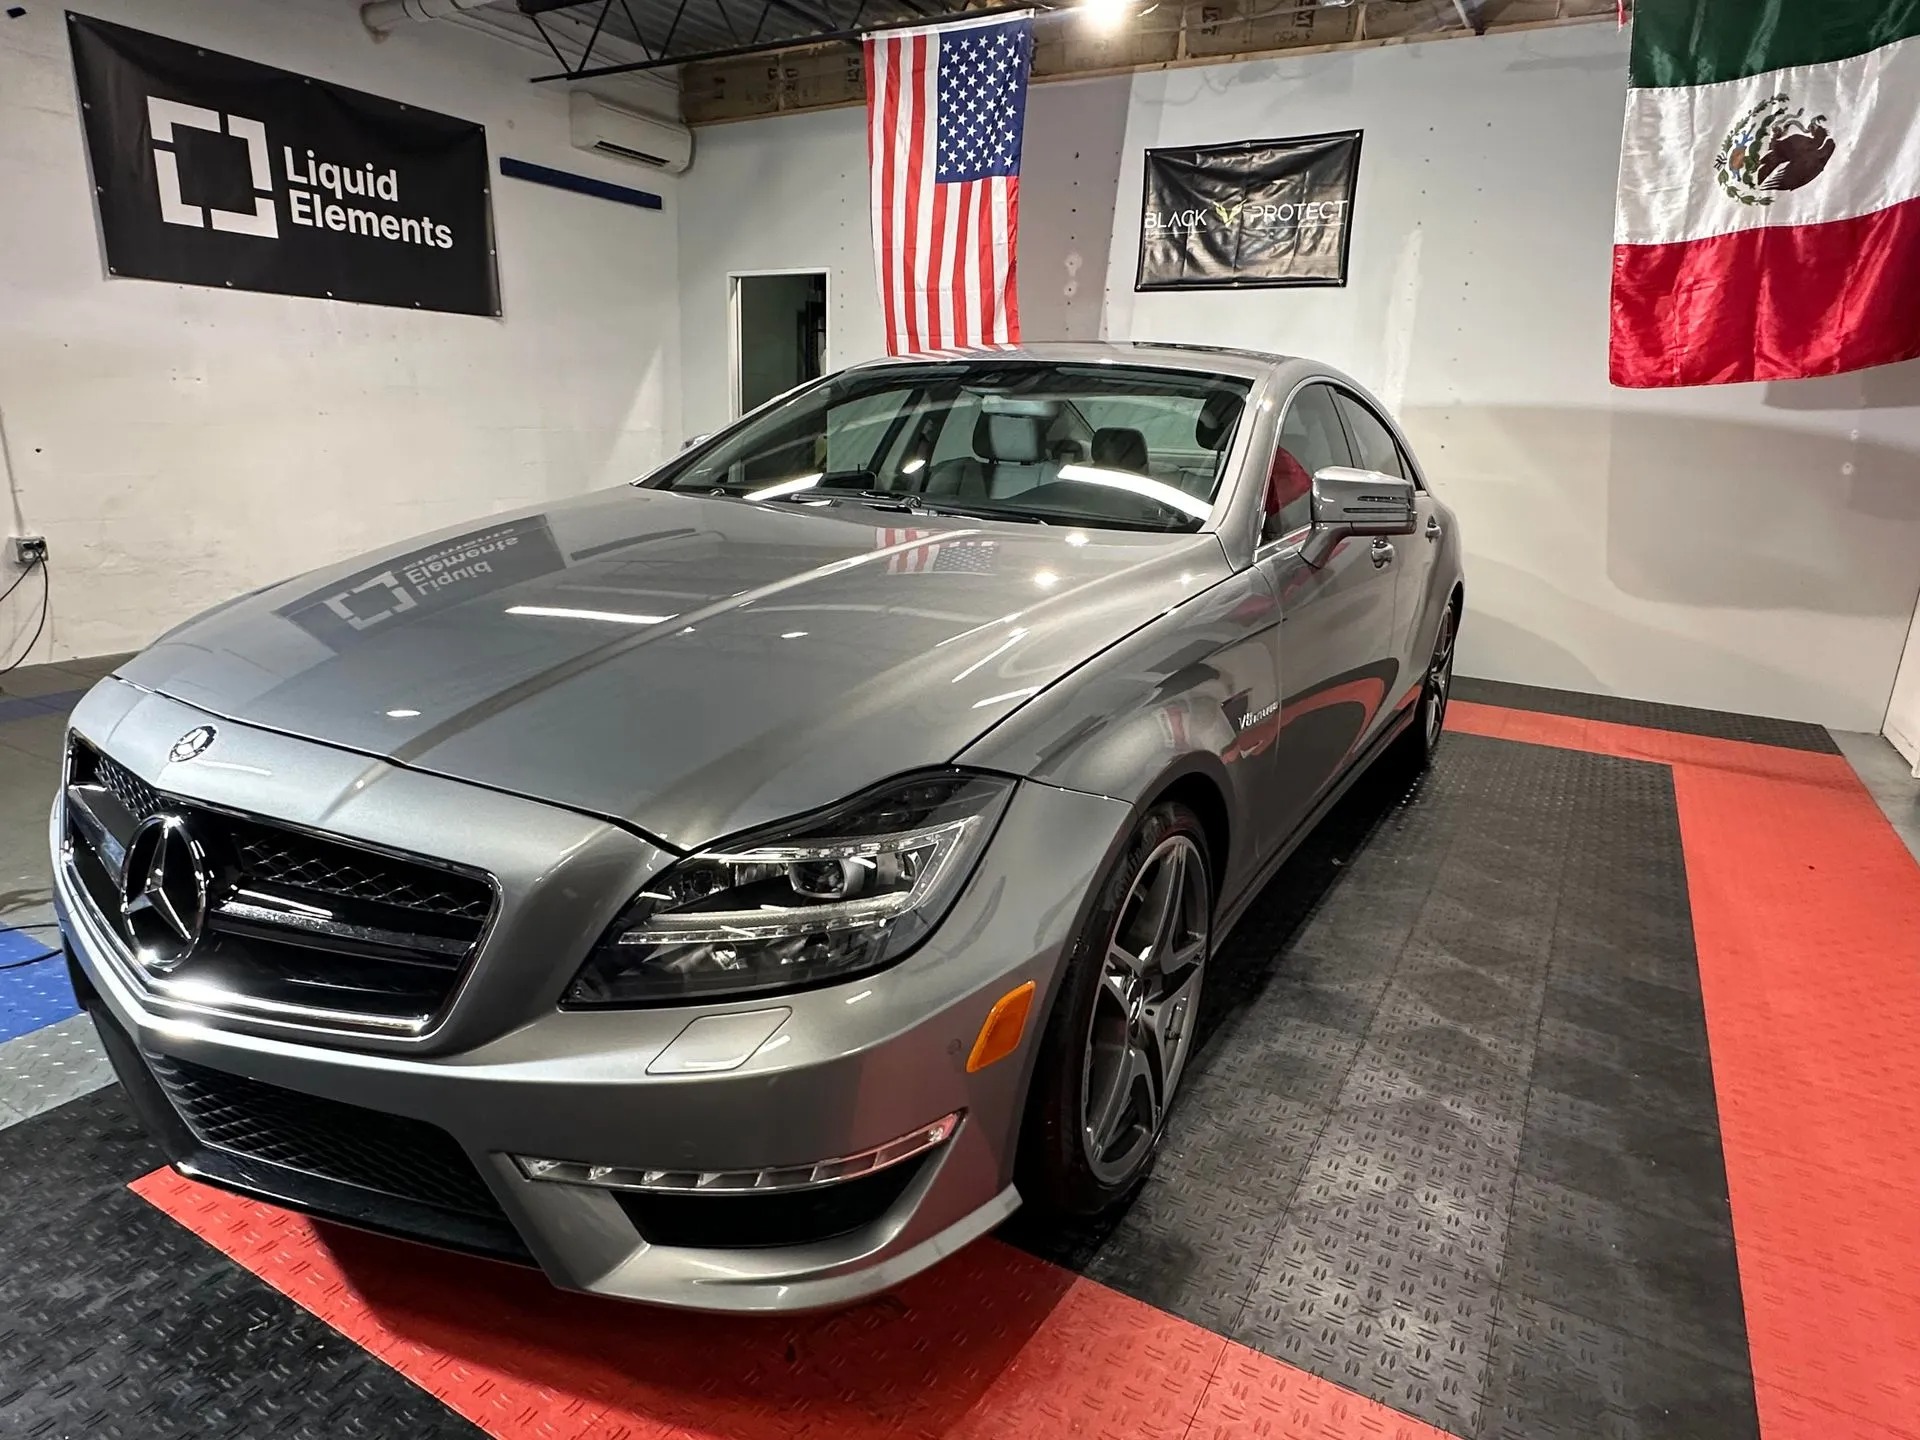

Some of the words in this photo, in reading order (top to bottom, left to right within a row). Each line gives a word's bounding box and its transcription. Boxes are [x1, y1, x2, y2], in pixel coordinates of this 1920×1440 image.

[283, 146, 399, 202] Liquid
[288, 188, 453, 249] Elements
[1144, 208, 1208, 229] BLACK
[1250, 200, 1348, 223] PROTECT
